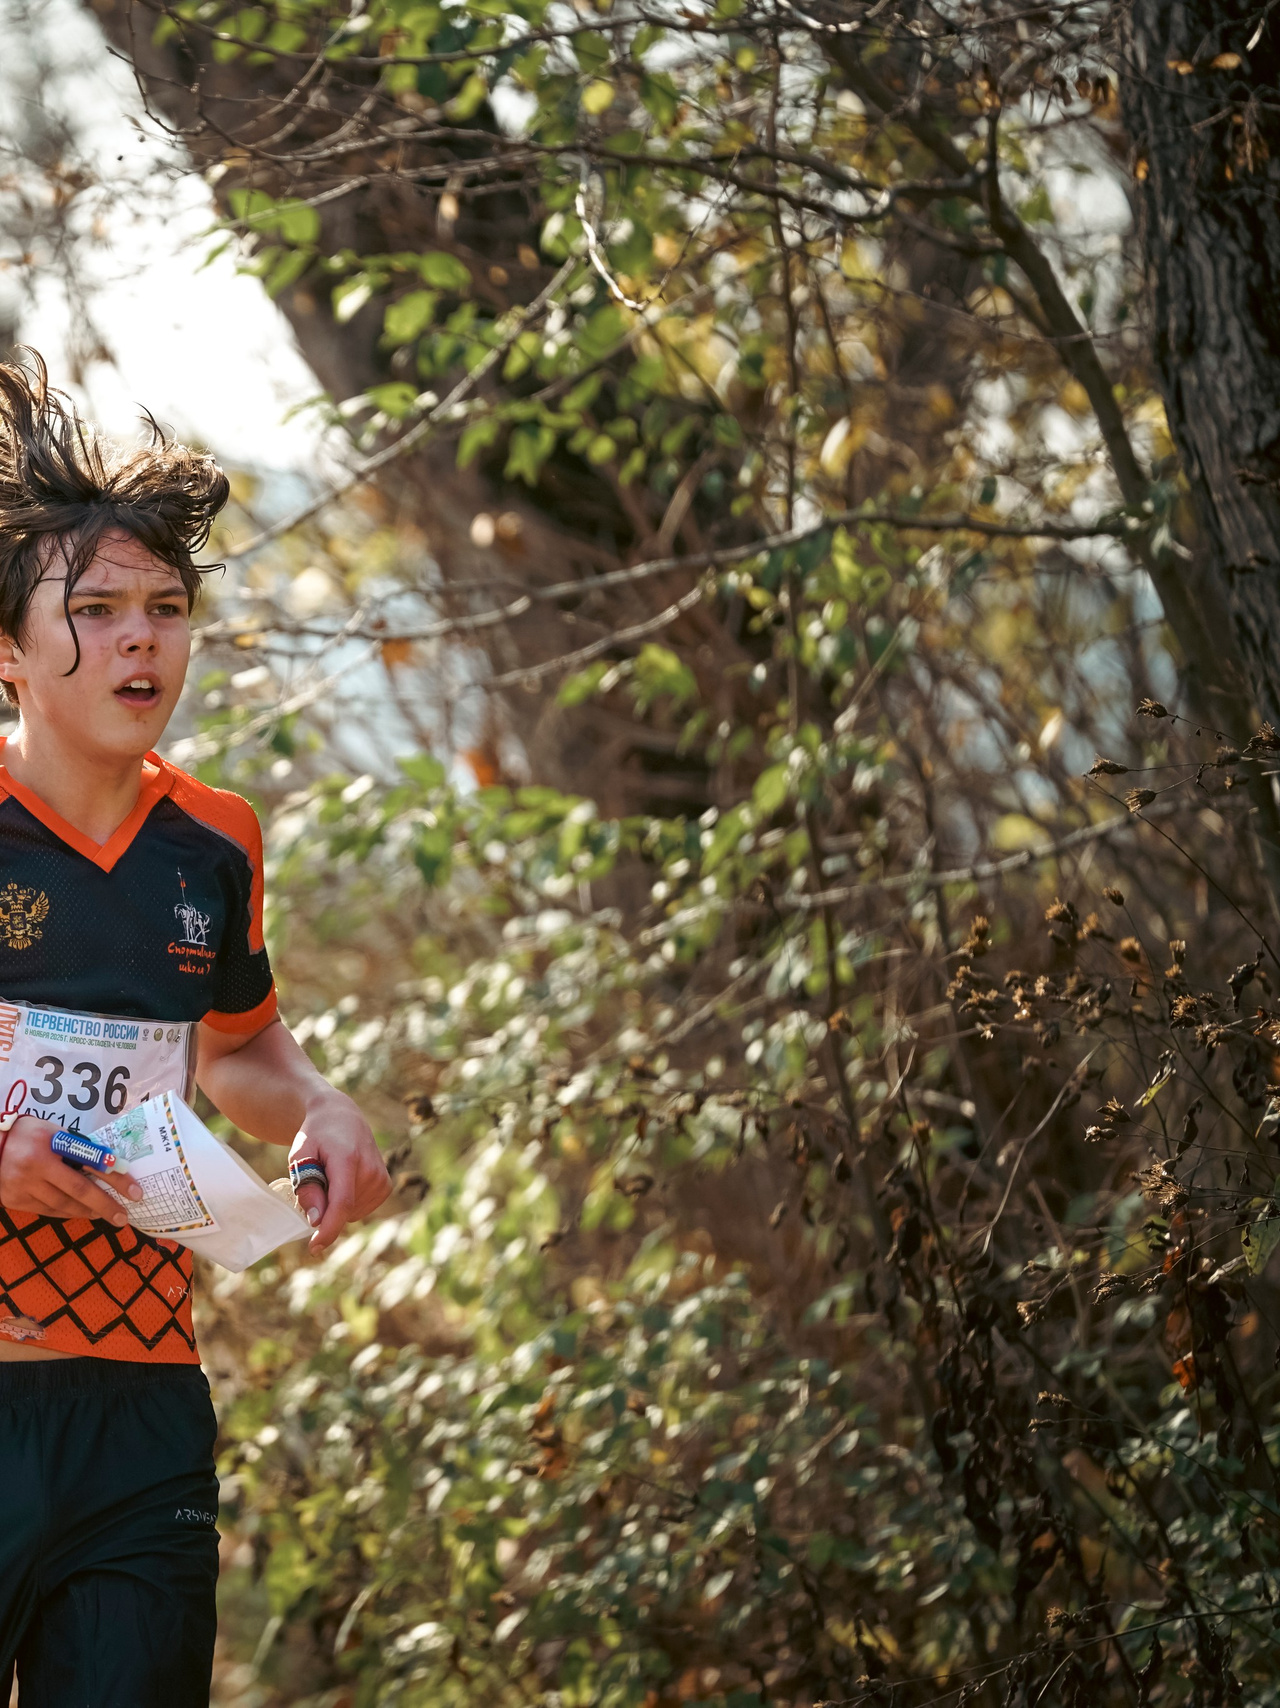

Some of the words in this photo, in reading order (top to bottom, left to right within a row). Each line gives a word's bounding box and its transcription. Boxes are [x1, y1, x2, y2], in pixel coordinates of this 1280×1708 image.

[24, 1027, 29, 1035] 8
[29, 1028, 50, 1040] НОЯБРЯ
[50, 1032, 64, 1042] 2025
[26, 1010, 101, 1037] ПЕРВЕНСТВО
[103, 1022, 140, 1041] РОССИИ
[30, 1055, 131, 1115] 336
[158, 1126, 173, 1153] МЖ14
